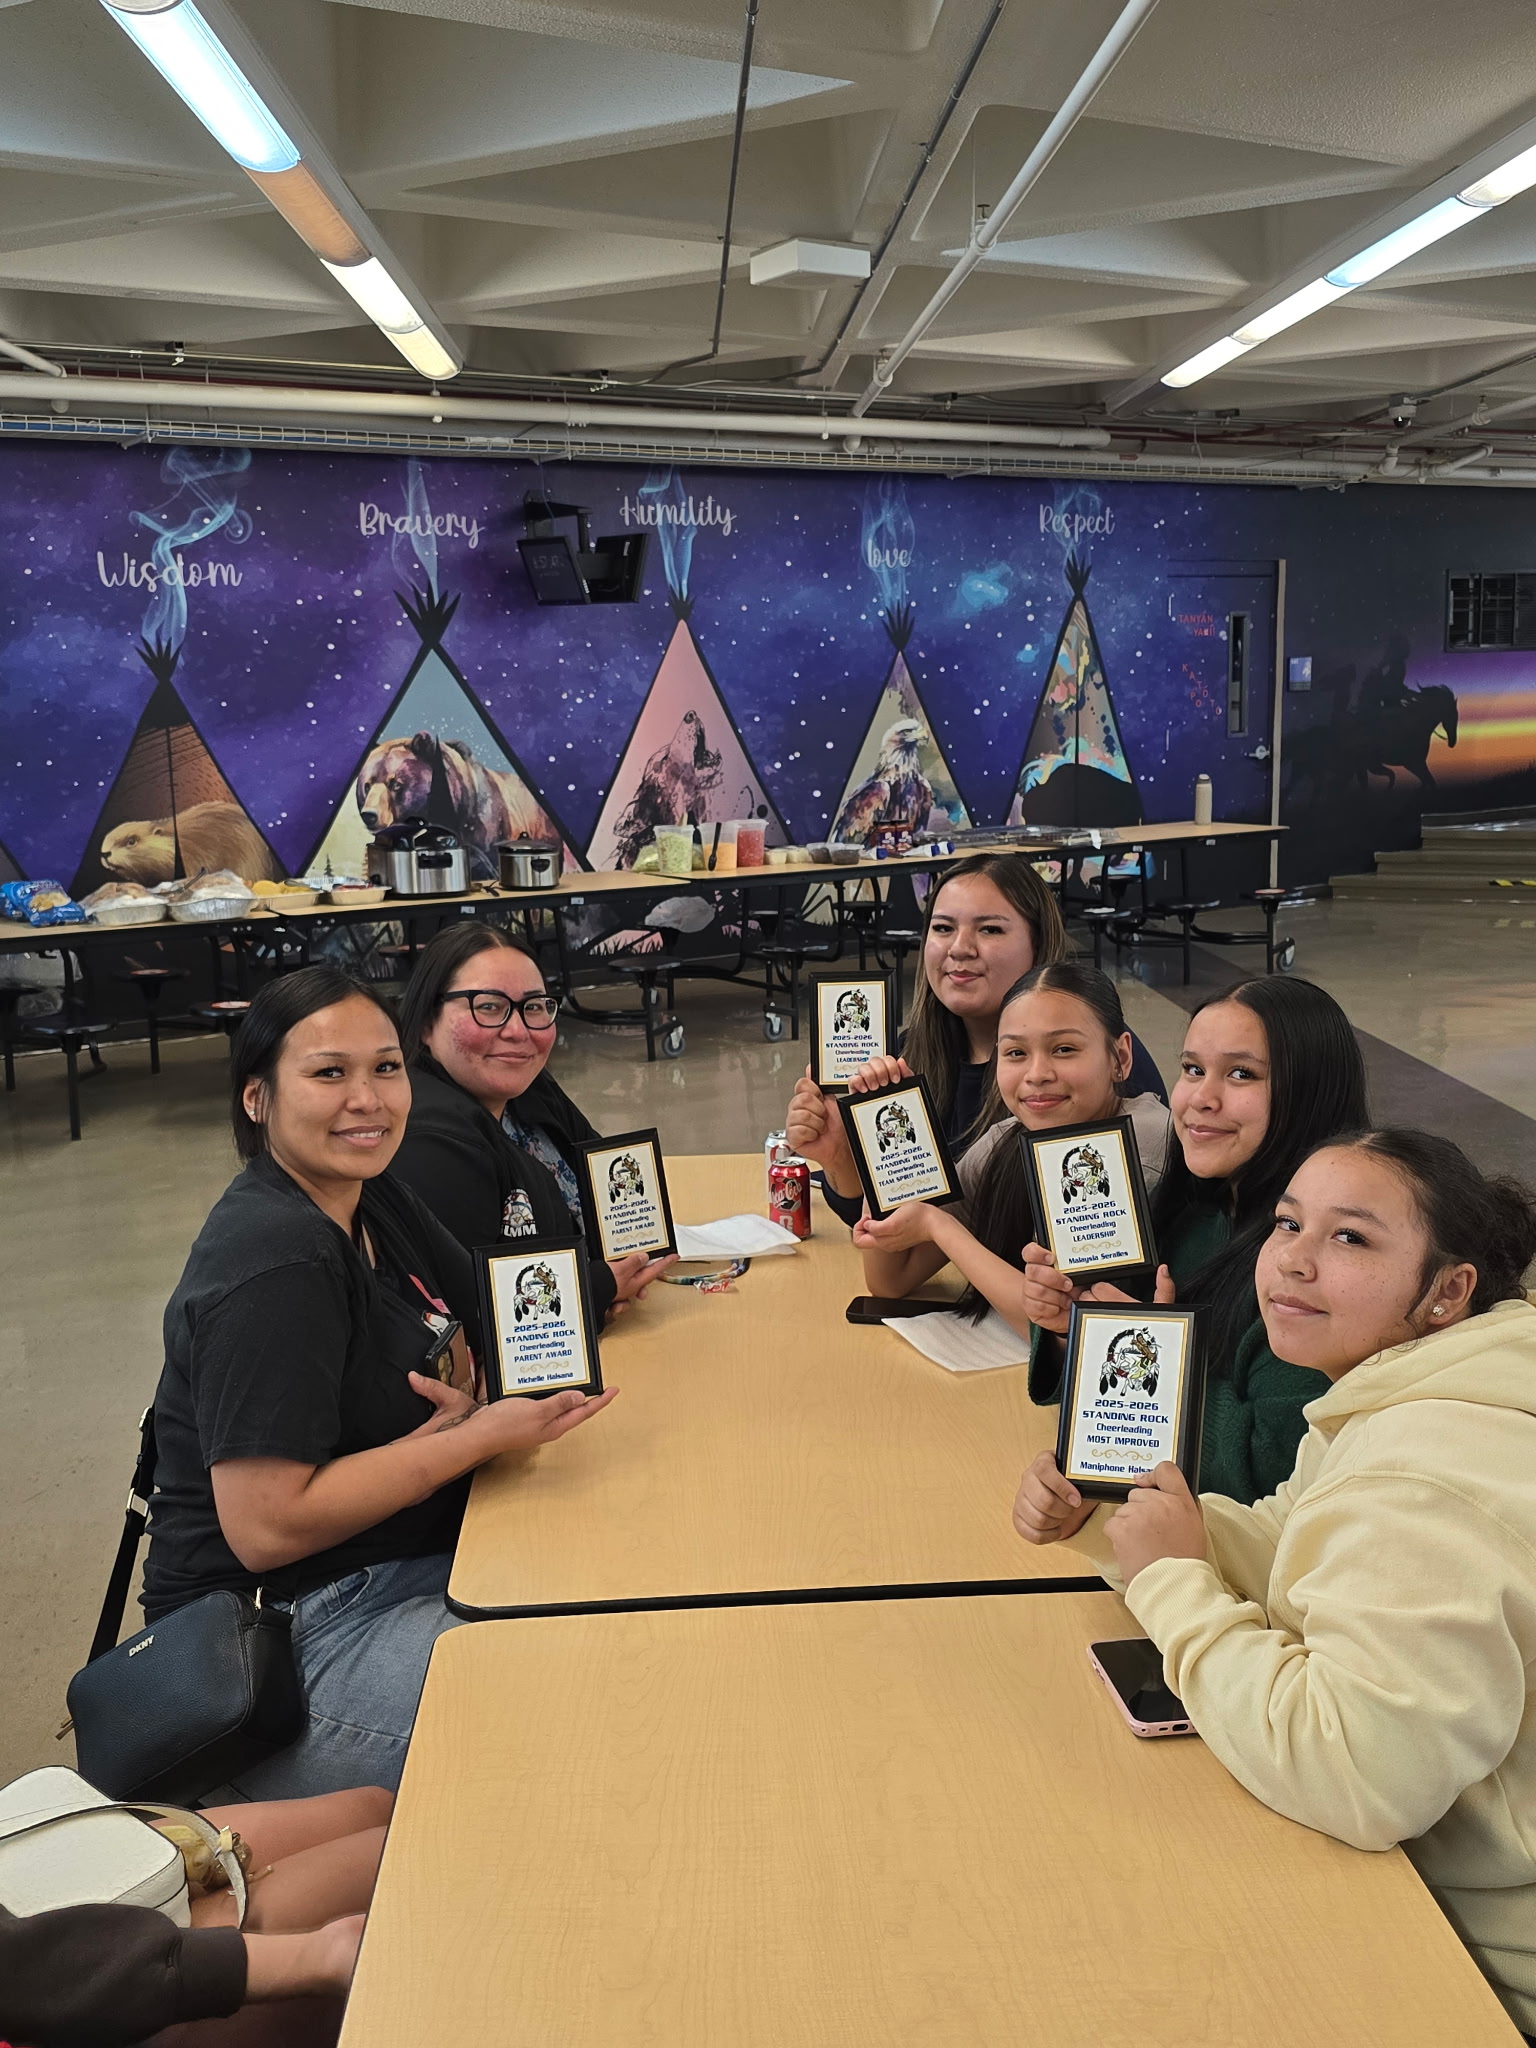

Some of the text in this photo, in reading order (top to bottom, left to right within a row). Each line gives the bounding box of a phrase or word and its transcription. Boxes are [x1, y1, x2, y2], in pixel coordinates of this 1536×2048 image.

[620, 495, 737, 536] Humility
[360, 502, 486, 549] Bravery
[1040, 504, 1115, 543] Respect
[97, 551, 243, 592] Wisdom
[880, 1146, 922, 1161] 2025-2026
[876, 1152, 932, 1171] STANDING ROCK
[888, 1162, 924, 1176] Cheerleading
[878, 1166, 938, 1187] TEAM SPIRIT AWARD
[604, 1205, 656, 1221] STANDING ROCK
[1064, 1200, 1116, 1214] 2025-2026
[615, 1216, 650, 1226] Cheerleading
[1056, 1208, 1126, 1225] STANDING ROCK
[612, 1222, 654, 1236] PARENT AWARD
[1070, 1220, 1116, 1232] Cheerleading
[1072, 1230, 1116, 1242] LEADERSHIP
[1068, 1254, 1098, 1264] Malaysia
[514, 1320, 566, 1332] 2025-2026
[506, 1329, 576, 1344] STANDING ROCK
[520, 1340, 565, 1352] Cheerleading
[514, 1349, 572, 1362] PARENT AWARD
[518, 1376, 544, 1384] Michelle
[1095, 1398, 1158, 1410] 2025-2026
[1082, 1410, 1168, 1424] STANDING ROCK
[1096, 1422, 1152, 1436] Cheerleading
[1086, 1434, 1160, 1448] MOST IMPROVED
[1080, 1461, 1154, 1474] Maniphone Halsa
[128, 1634, 155, 1657] DKNY
